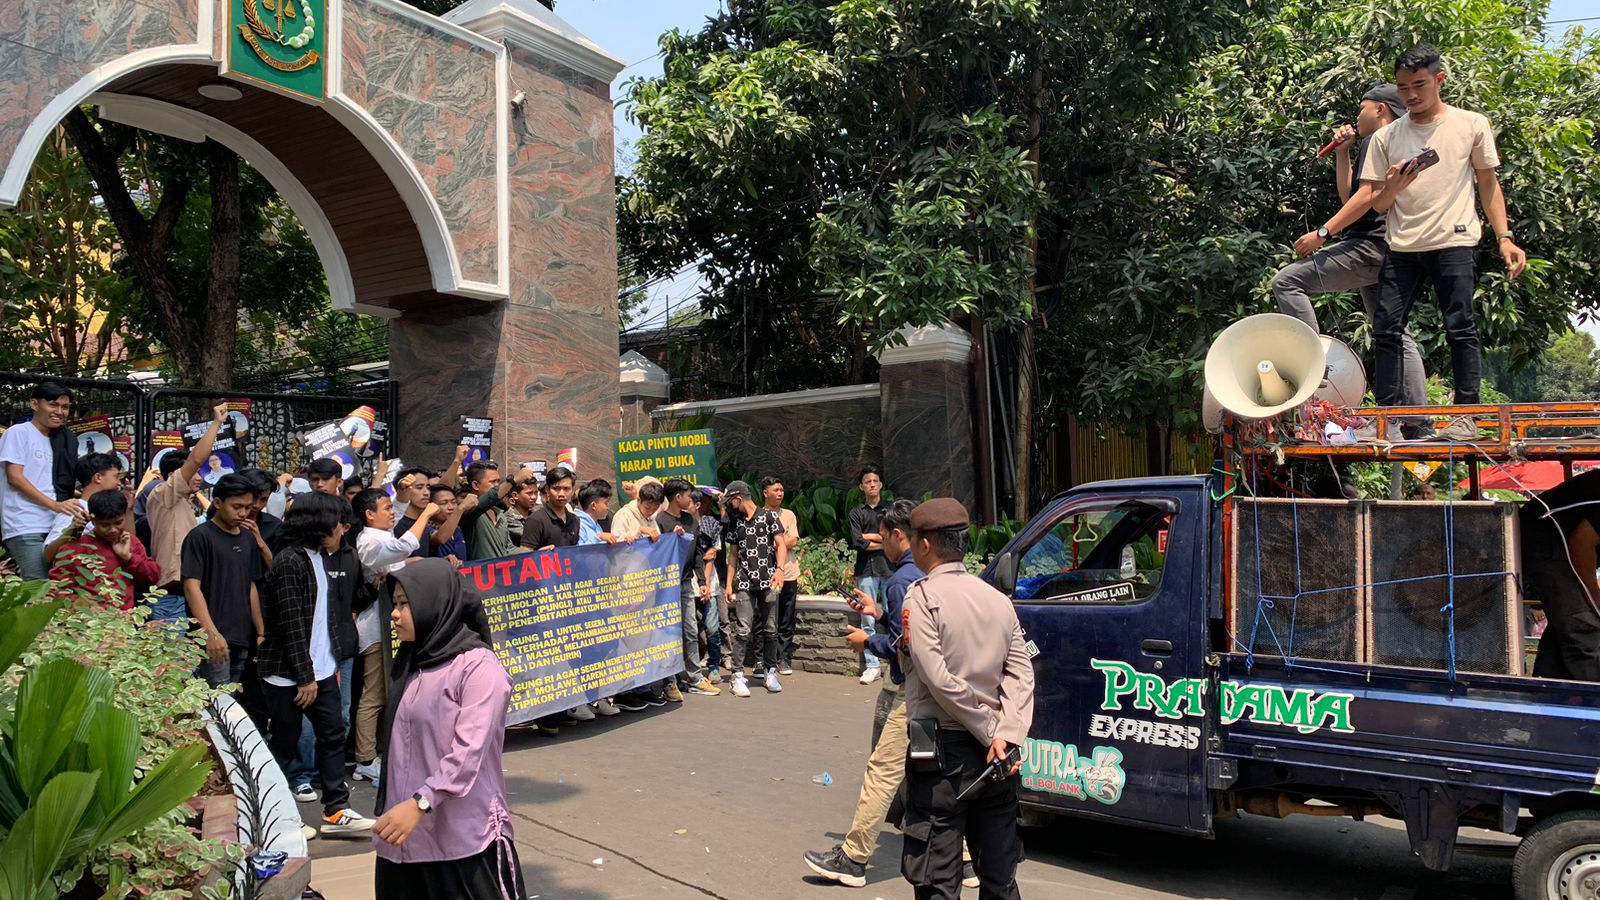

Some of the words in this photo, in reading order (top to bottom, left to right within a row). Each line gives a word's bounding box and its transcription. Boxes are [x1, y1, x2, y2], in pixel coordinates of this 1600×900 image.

[619, 440, 645, 453] KACA
[647, 437, 677, 450] PINTU
[680, 434, 710, 447] MOBIL
[620, 459, 653, 473] HARAP
[656, 457, 665, 469] DI
[668, 454, 695, 468] BUKA
[484, 605, 503, 616] LAS
[505, 604, 509, 612] I
[511, 595, 554, 610] MOLAWE
[601, 583, 622, 593] UTARA
[623, 579, 644, 589] YANG
[554, 583, 572, 593] LAUT
[1081, 589, 1108, 601] ORANG
[1109, 586, 1130, 598] LAIN
[507, 609, 530, 620] LIAR
[537, 600, 573, 615] (PUNGLI)
[577, 596, 592, 606] ATAU
[508, 610, 567, 629] PENERBITAN
[568, 605, 588, 617] SURAT
[505, 634, 539, 648] AGUNG
[543, 630, 553, 639] RI
[557, 624, 583, 636] UNTUK
[516, 636, 569, 654] TERHADAP
[499, 655, 522, 667] UAT
[526, 646, 562, 661] MASUK
[564, 638, 595, 652] MELALUI
[509, 664, 527, 676] (BL)
[529, 657, 550, 670] DAN
[552, 650, 582, 665] (SURIN)
[526, 690, 530, 698] I
[536, 679, 577, 695] MOLAWE
[580, 669, 608, 683] KARENA
[544, 675, 554, 684] RI
[556, 668, 580, 681] AGAR
[580, 660, 606, 674] SEGERA
[513, 693, 555, 711] TIPIKOR
[555, 689, 571, 700] PT.
[572, 681, 599, 695] ANTAM
[1091, 658, 1356, 735] PRATAMA
[1088, 713, 1201, 750] EXPRESS
[1019, 739, 1078, 779] PUTRA
